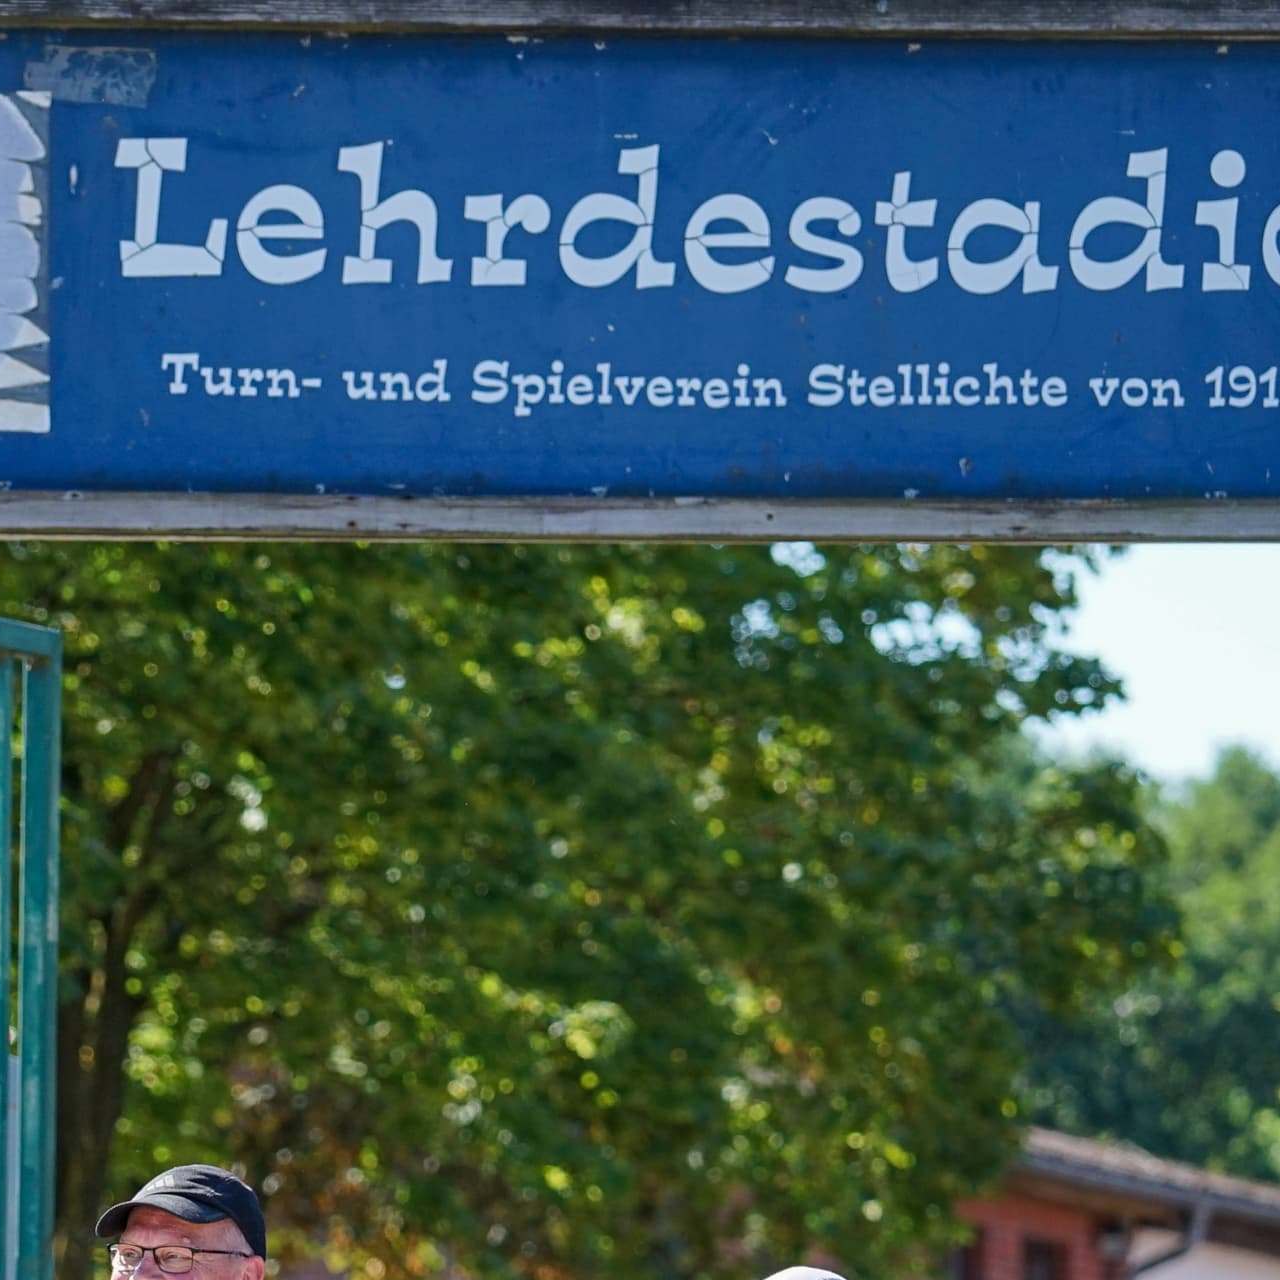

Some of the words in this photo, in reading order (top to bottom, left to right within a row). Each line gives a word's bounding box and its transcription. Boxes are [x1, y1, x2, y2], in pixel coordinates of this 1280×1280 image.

[162, 353, 322, 396] Turn-
[342, 358, 452, 402] und
[471, 360, 788, 416] Spielverein
[807, 362, 1068, 408] Stellichte
[1089, 376, 1185, 408] von
